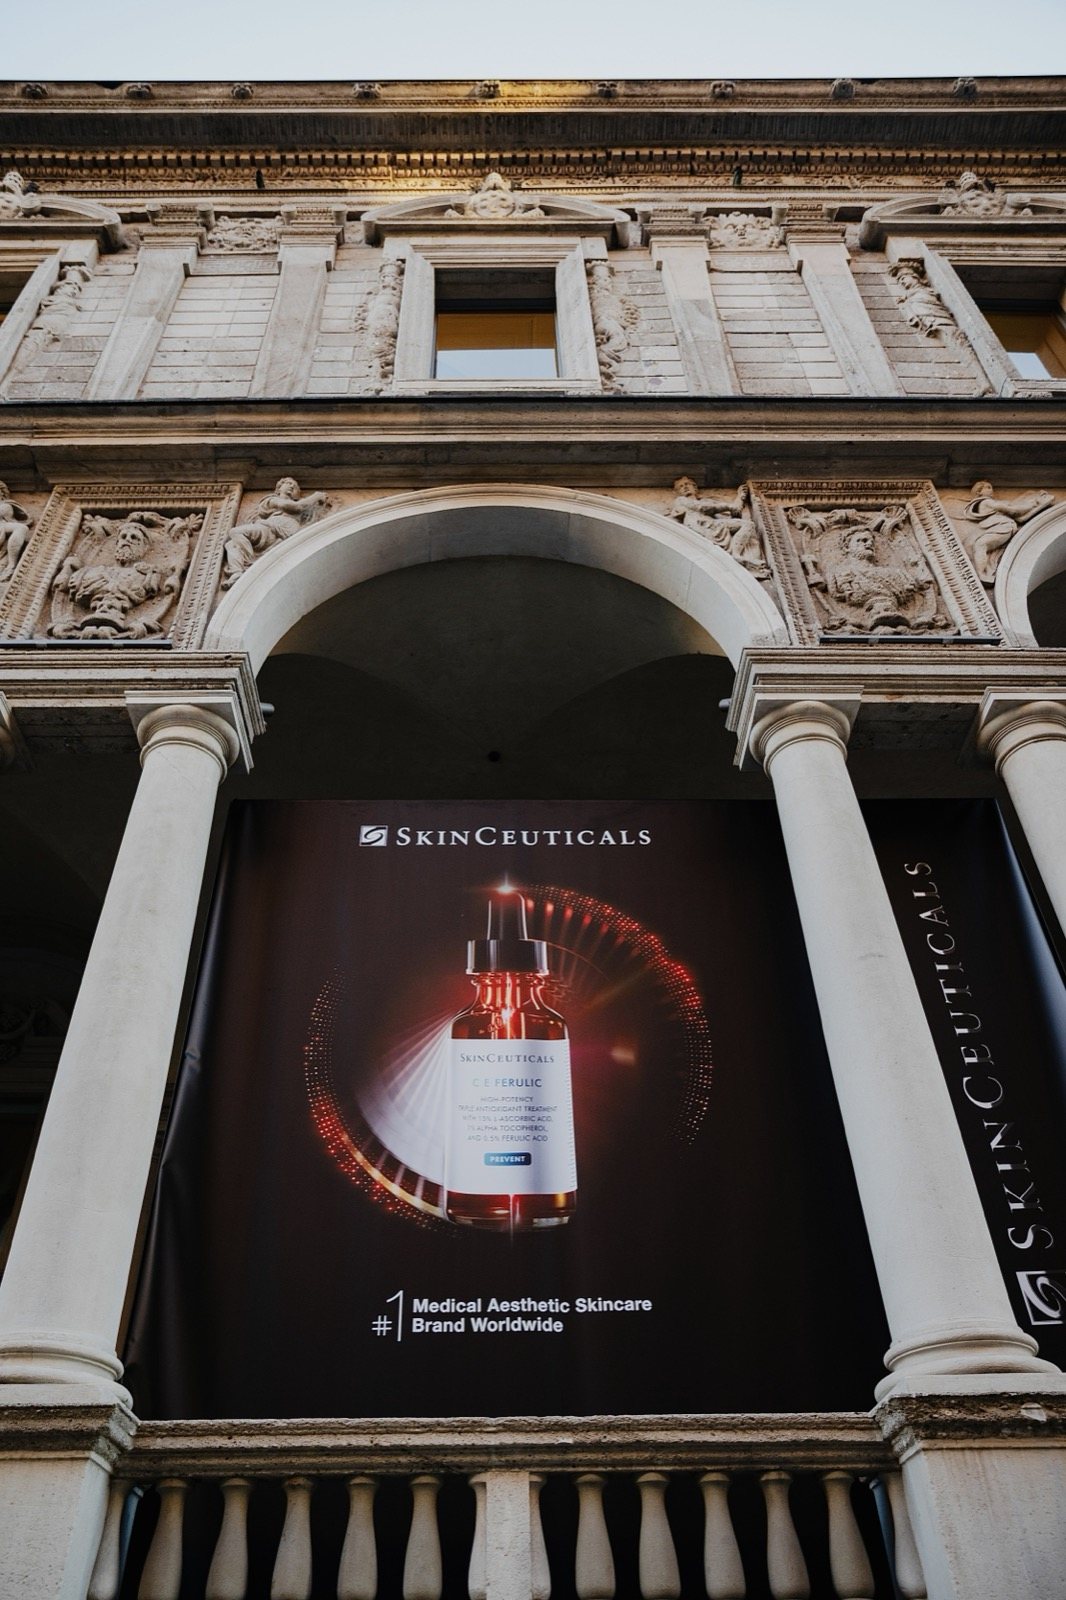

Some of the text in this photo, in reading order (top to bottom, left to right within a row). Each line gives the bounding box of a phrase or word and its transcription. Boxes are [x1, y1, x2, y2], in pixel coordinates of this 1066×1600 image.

[495, 1078, 542, 1087] FERULIC
[489, 1155, 527, 1163] PREVENT
[412, 1297, 653, 1314] Medical Aesthetic Skincare
[411, 1317, 564, 1333] Brand Worldwide
